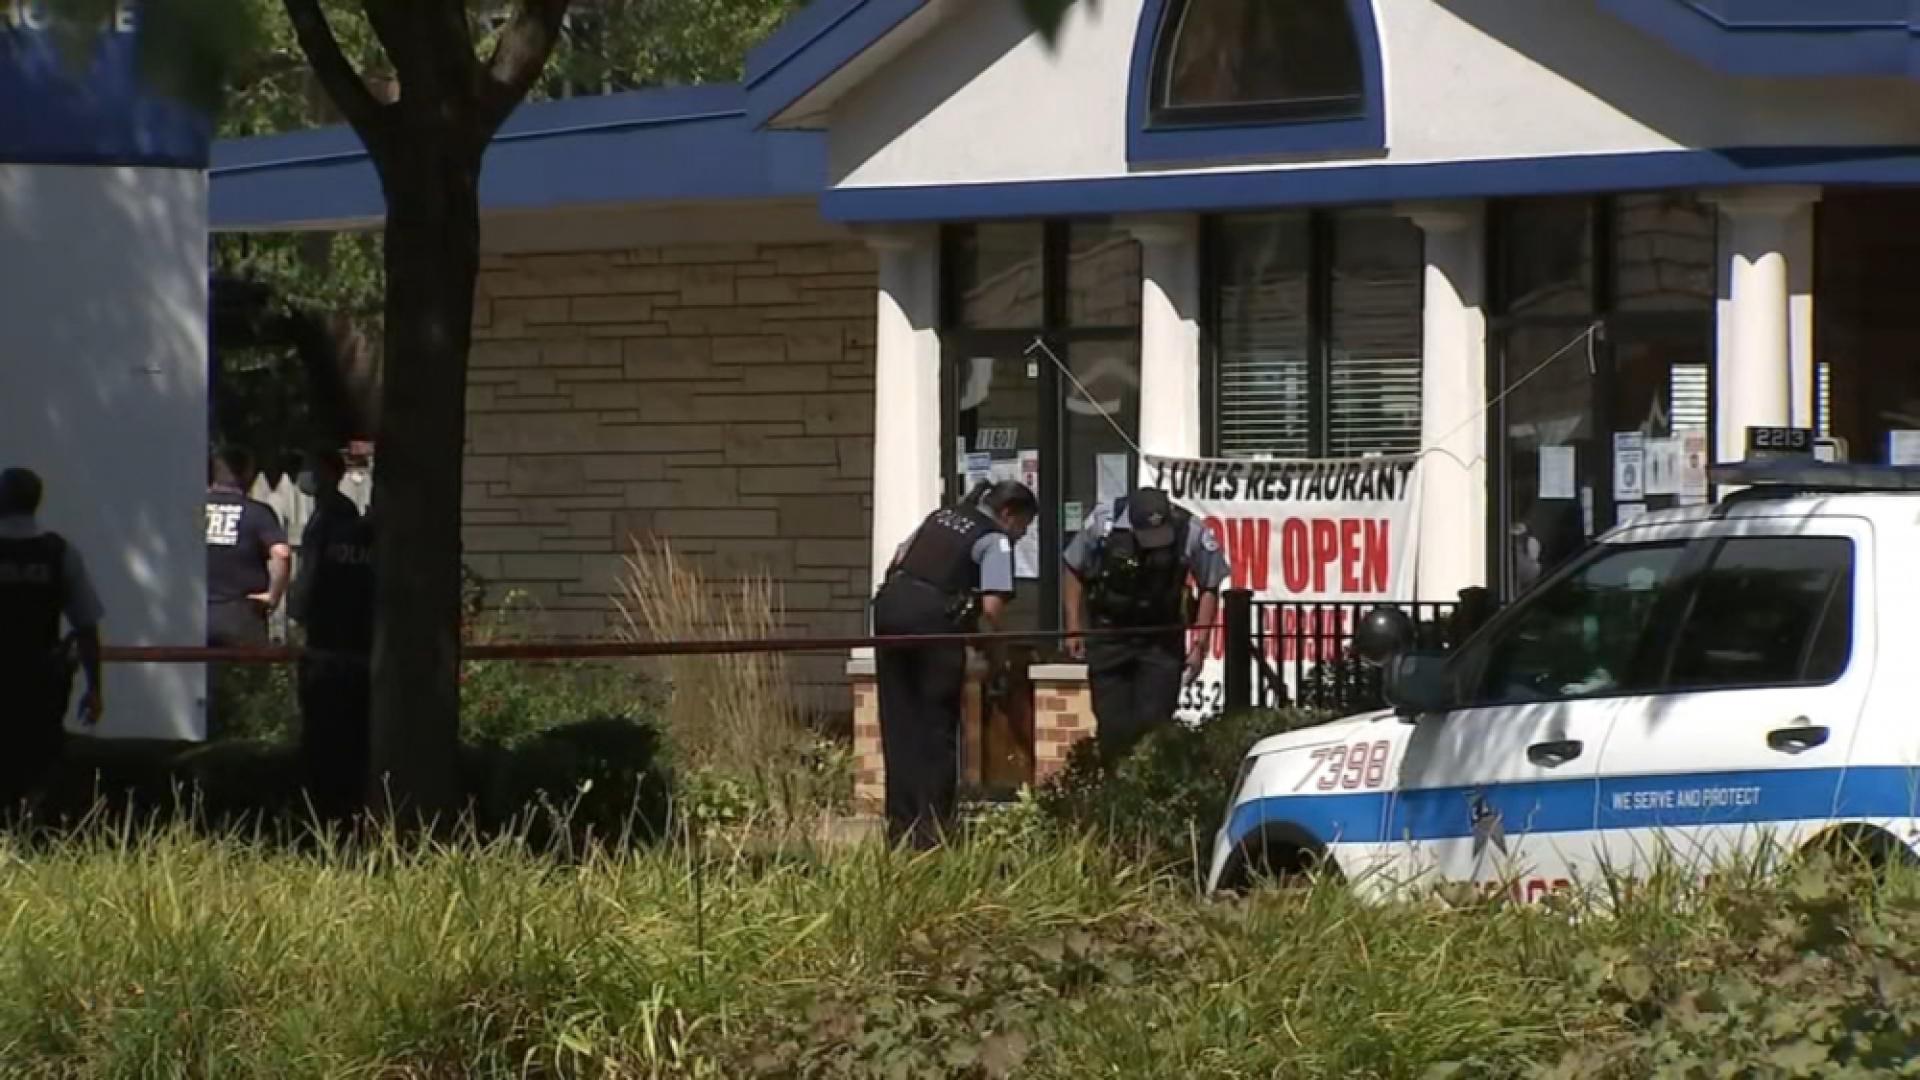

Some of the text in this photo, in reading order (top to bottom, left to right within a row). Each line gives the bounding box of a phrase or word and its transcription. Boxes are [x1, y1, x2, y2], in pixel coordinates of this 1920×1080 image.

[1756, 429, 1804, 447] 2213
[1246, 462, 1411, 501] RESTAURANT
[1282, 517, 1390, 594] OPEN
[1292, 739, 1390, 791] 7398
[1612, 787, 1760, 809] WE SERVE AND PROTECT
